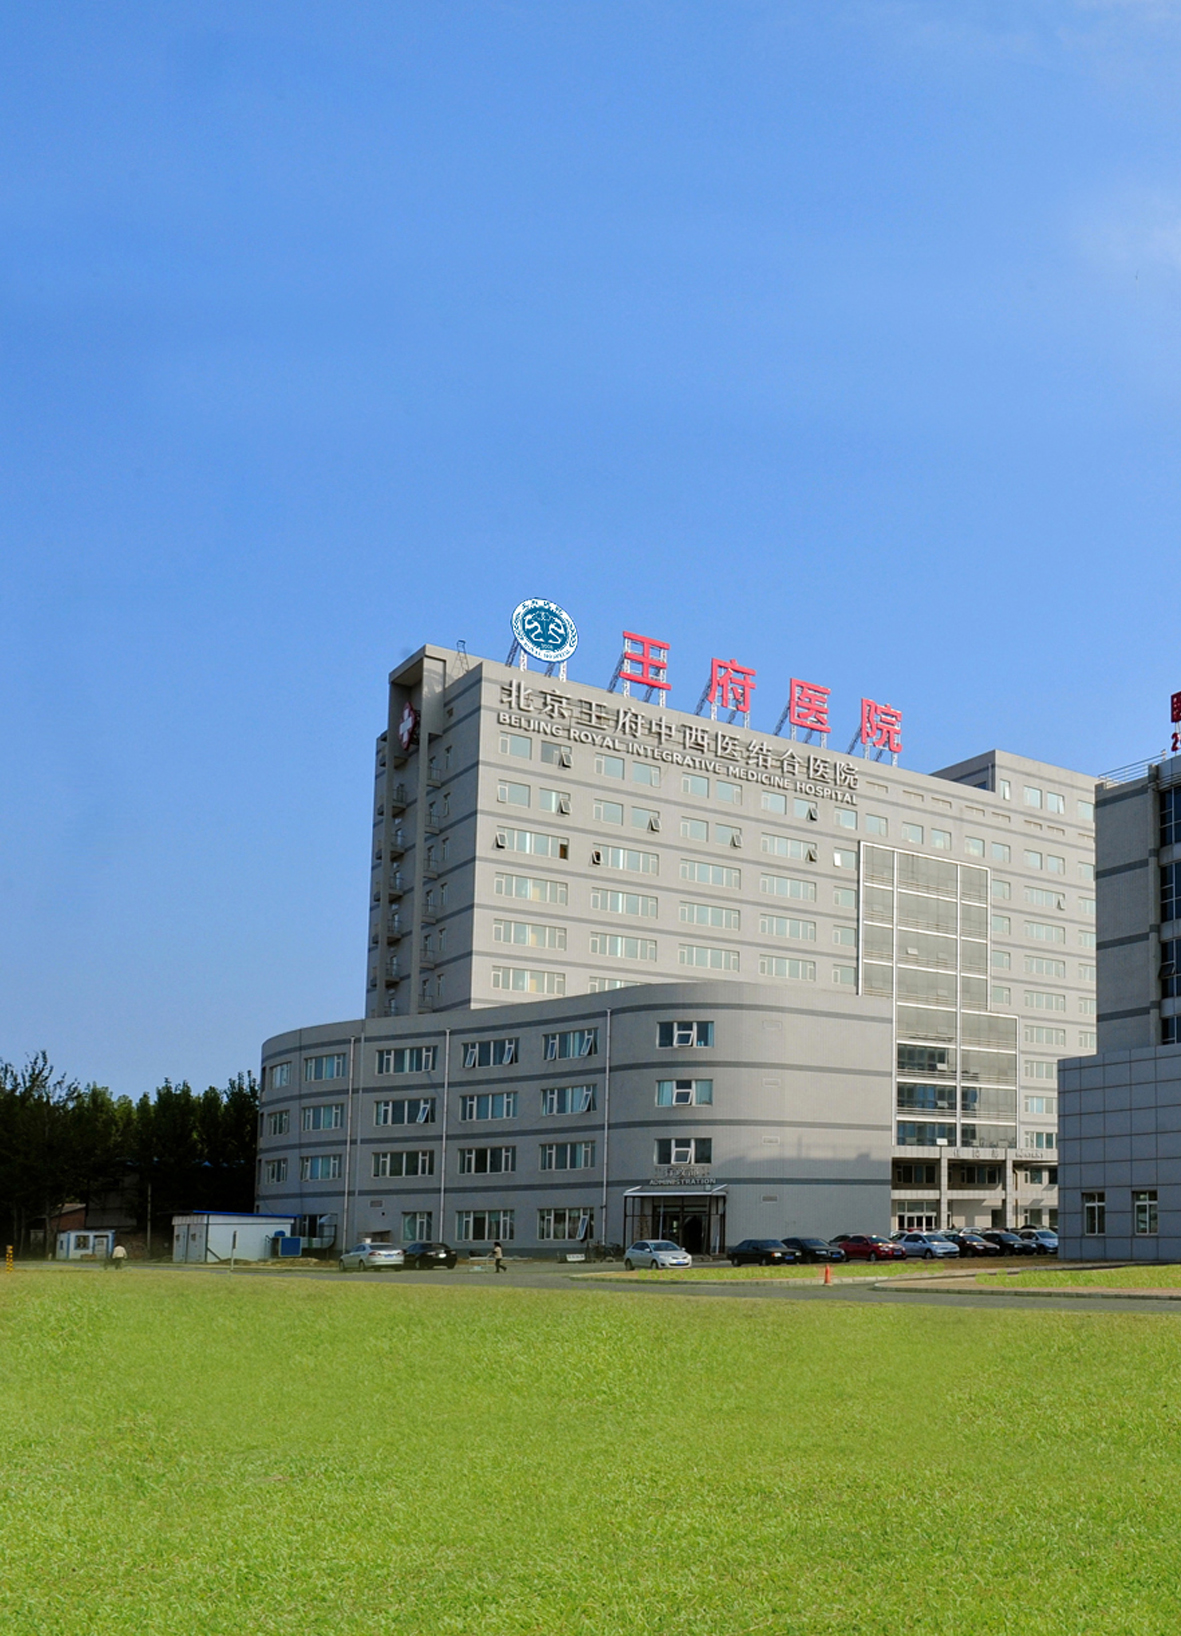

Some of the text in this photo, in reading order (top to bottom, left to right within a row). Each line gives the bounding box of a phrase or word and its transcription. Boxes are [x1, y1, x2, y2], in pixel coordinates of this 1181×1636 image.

[501, 679, 858, 789] 北京王府中西医结合医院
[619, 631, 902, 753] 王府医院
[499, 712, 859, 806] BEIJING ROYAL INTEGRATIVE MEDICINE HOSPITAL
